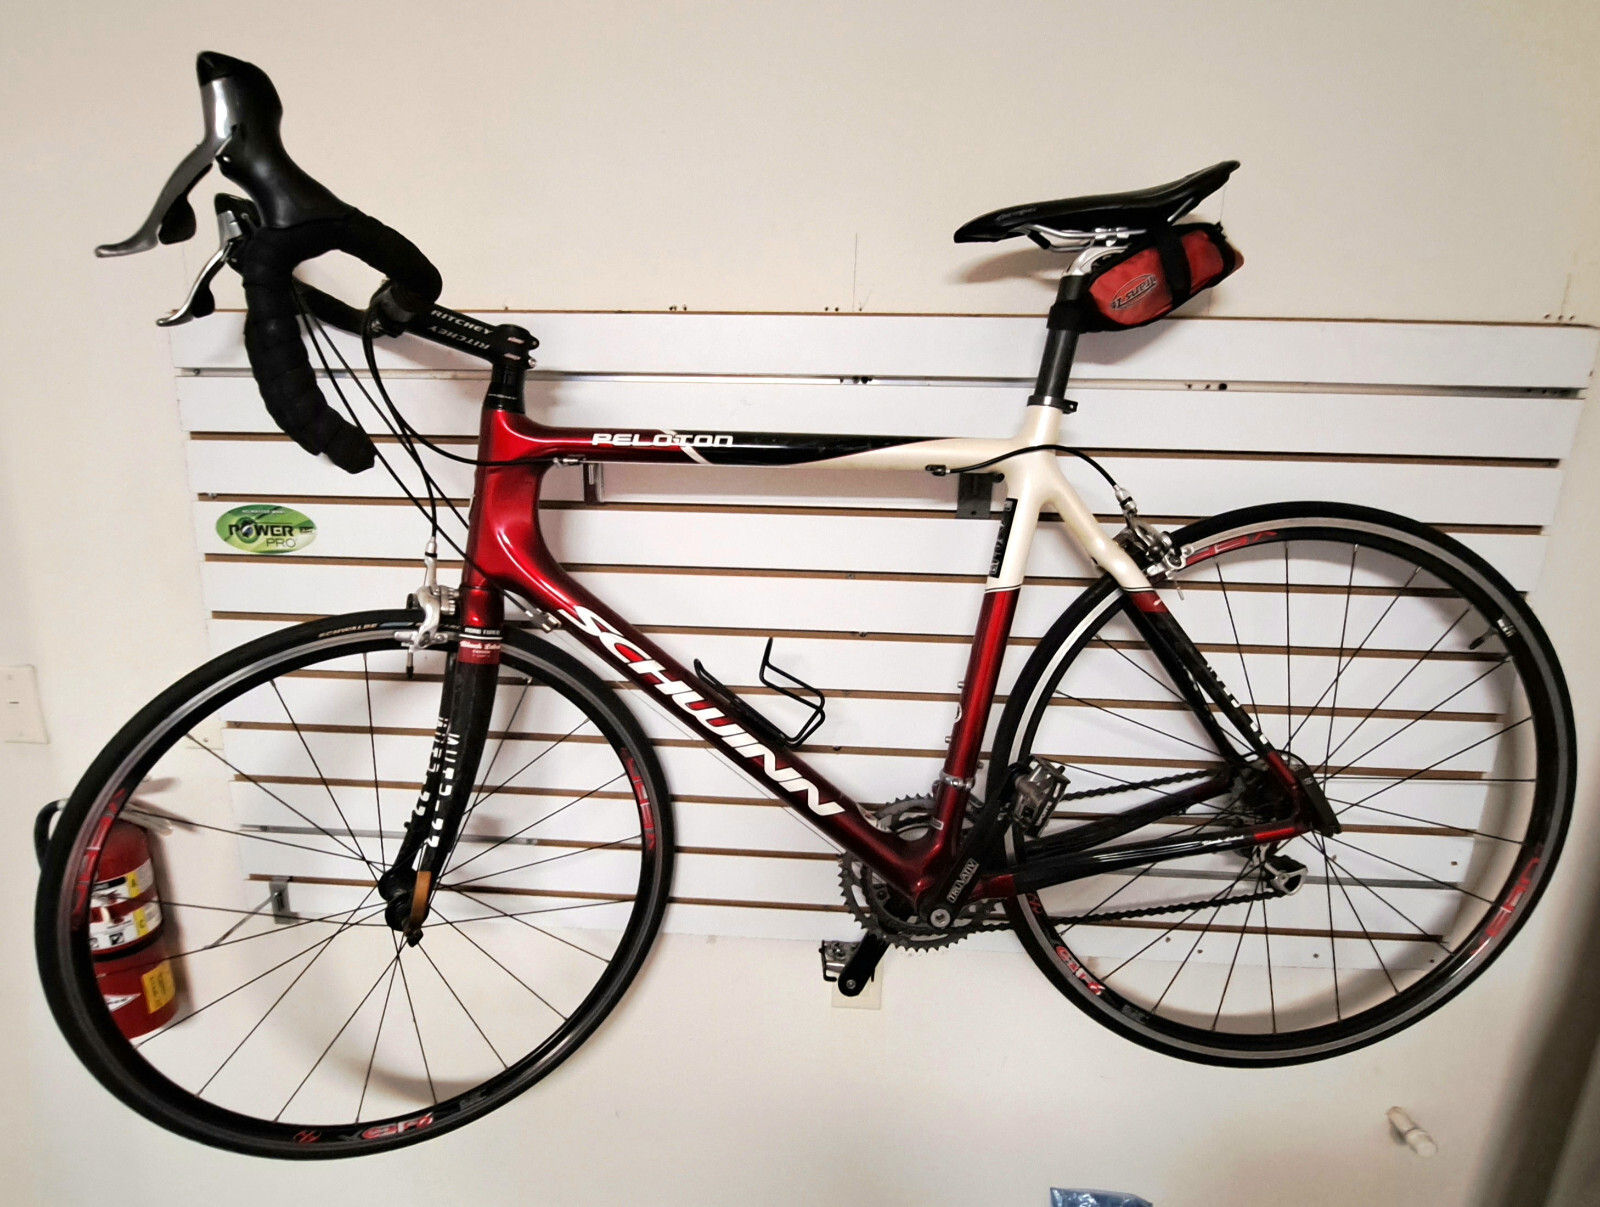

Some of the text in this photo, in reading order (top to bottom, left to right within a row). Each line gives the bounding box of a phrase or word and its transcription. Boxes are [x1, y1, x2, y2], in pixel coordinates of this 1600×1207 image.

[430, 308, 494, 336] RITCHEY
[427, 324, 491, 351] RITCHEY
[591, 432, 734, 449] PELOTON
[227, 520, 295, 538] POWER
[265, 537, 297, 548] PRO
[556, 604, 847, 817] SCHWINN
